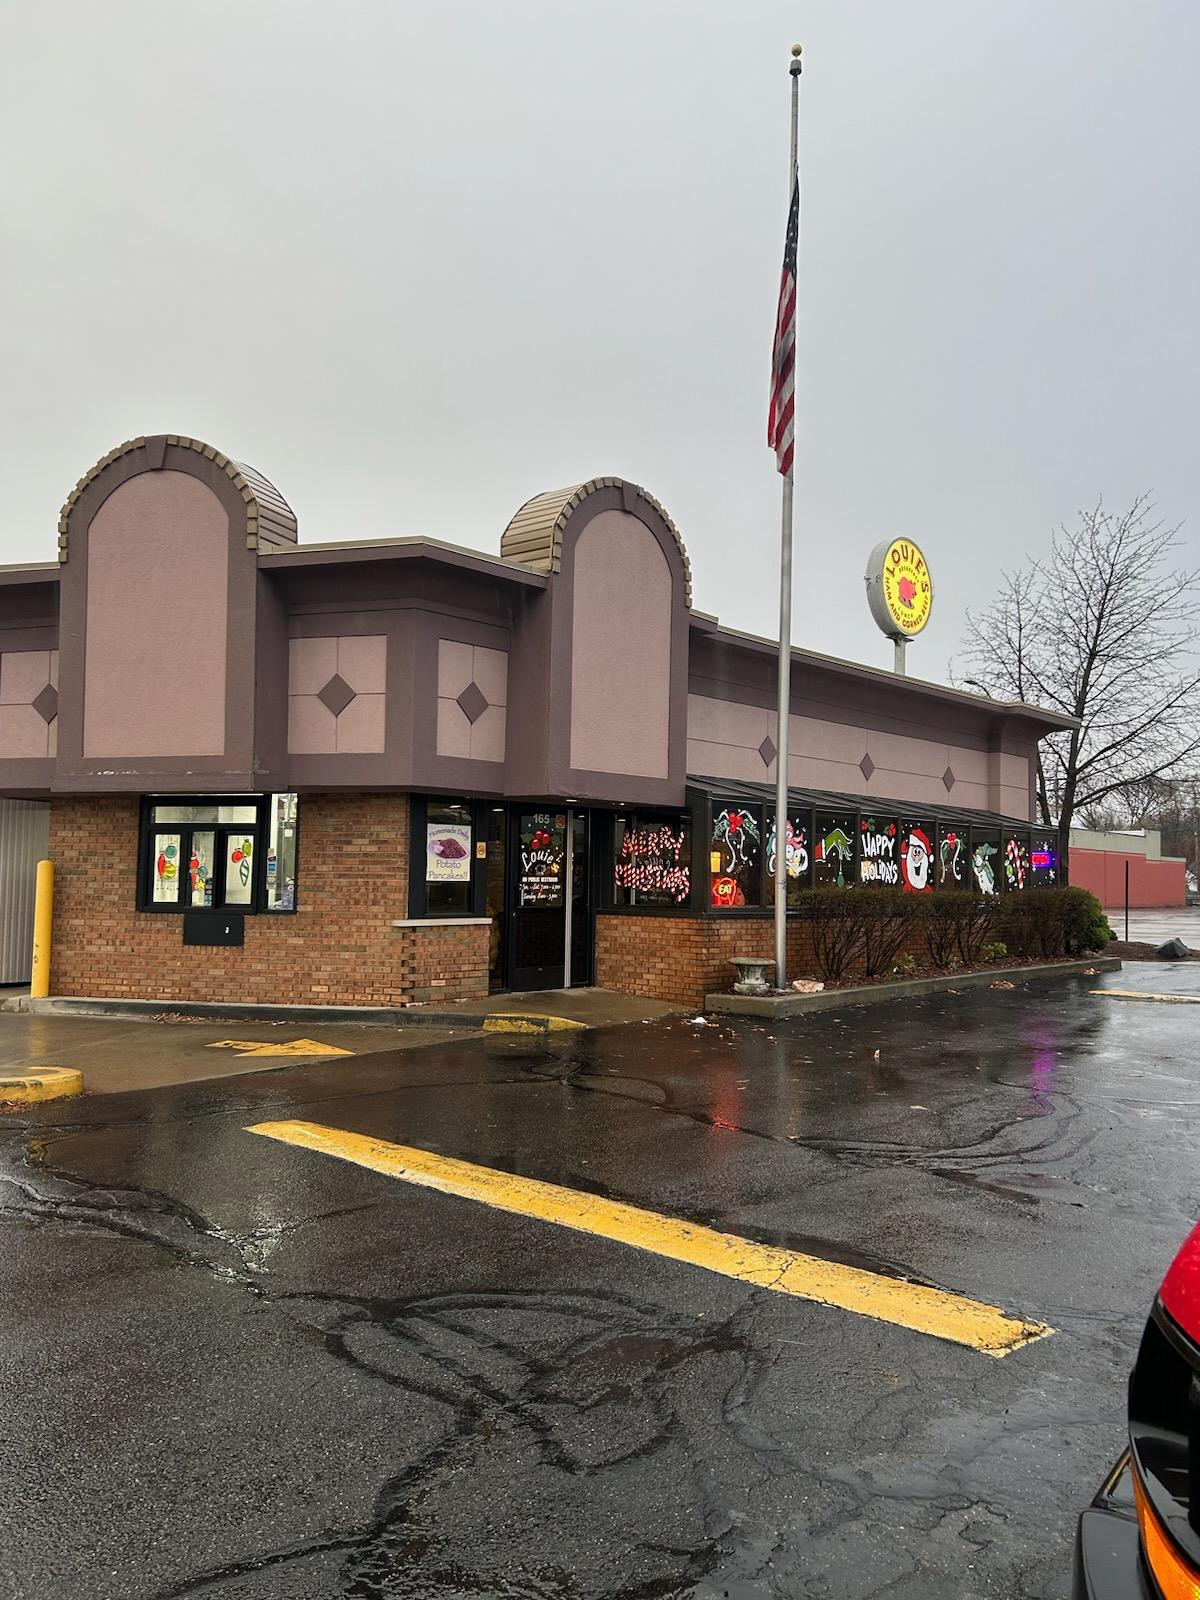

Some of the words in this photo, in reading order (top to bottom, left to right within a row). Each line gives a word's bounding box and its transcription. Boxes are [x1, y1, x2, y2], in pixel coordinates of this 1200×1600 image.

[886, 544, 929, 593] LOUIE'S
[890, 604, 901, 621] AND
[902, 615, 922, 628] CORNED
[533, 814, 550, 824] 165
[429, 826, 457, 838] Homemade
[457, 829, 469, 841] Daily
[622, 826, 685, 861] MERRY
[861, 832, 895, 857] HAPPY
[436, 860, 461, 869] Potato
[429, 871, 468, 880] Pancakes!!
[719, 884, 732, 895] EAT
